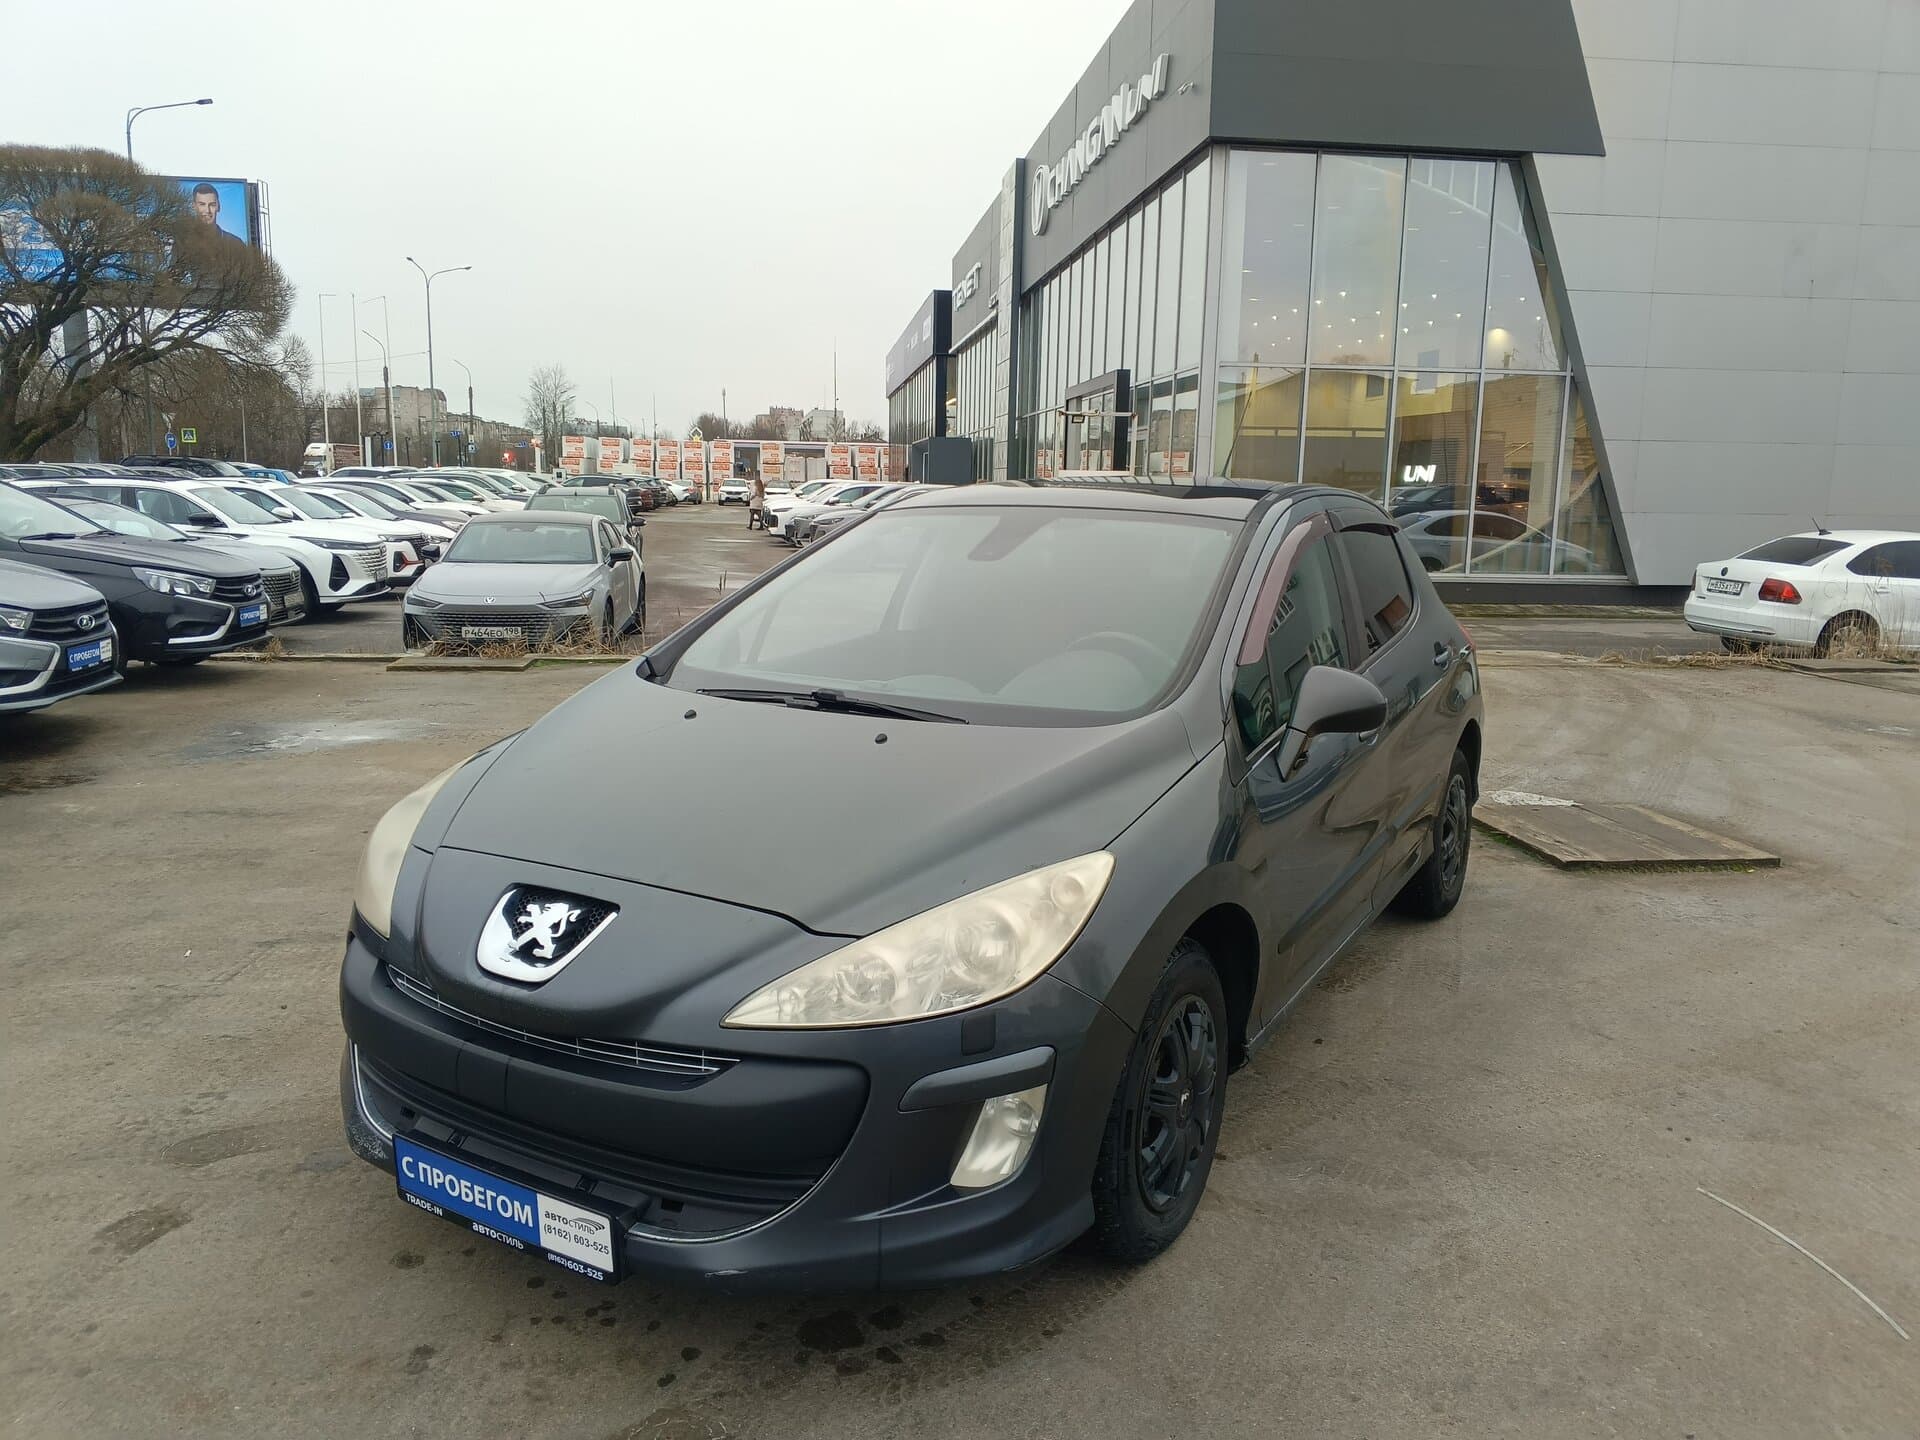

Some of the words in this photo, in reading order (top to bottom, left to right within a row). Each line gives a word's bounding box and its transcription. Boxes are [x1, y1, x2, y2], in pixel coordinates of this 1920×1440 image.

[1047, 82, 1130, 209] CHANGAN
[1126, 53, 1169, 126] UNI
[1403, 464, 1437, 483] UNI
[401, 1155, 416, 1179] С
[418, 1161, 533, 1228] ПРОБЕГОМ
[405, 1192, 444, 1217] TRADE-IN
[543, 1223, 572, 1242] (8162)
[573, 1233, 610, 1255] 603-525
